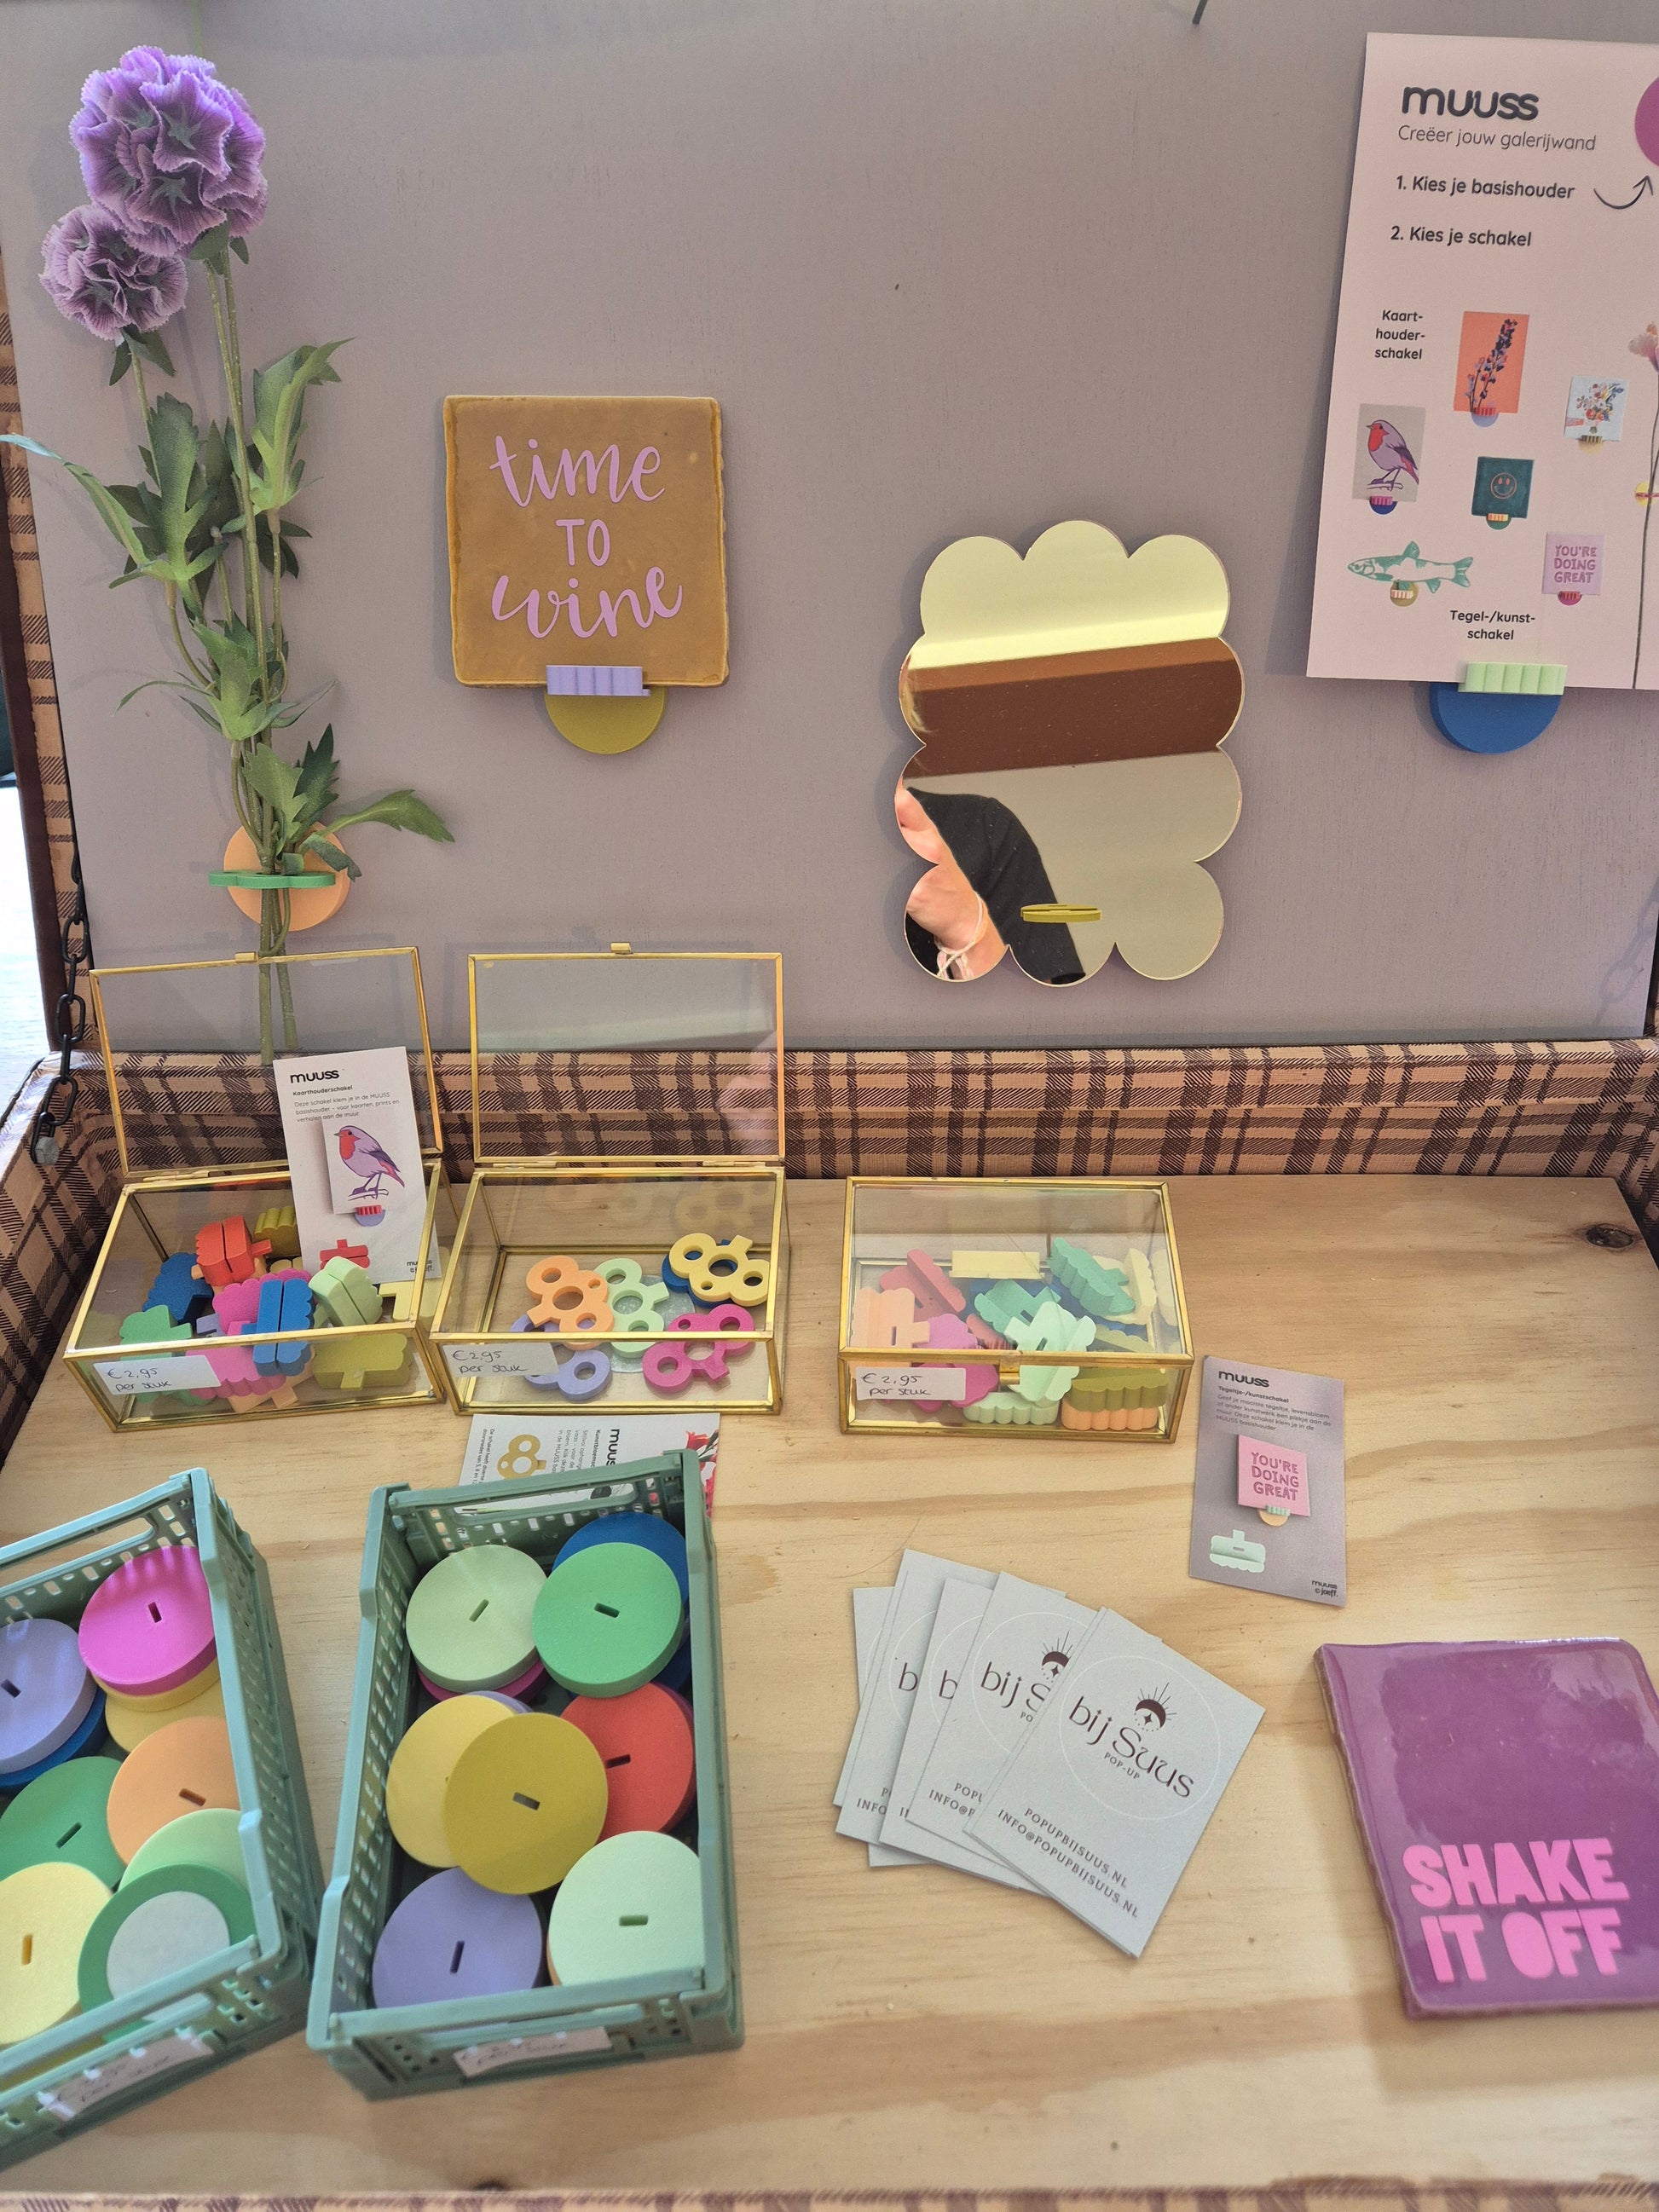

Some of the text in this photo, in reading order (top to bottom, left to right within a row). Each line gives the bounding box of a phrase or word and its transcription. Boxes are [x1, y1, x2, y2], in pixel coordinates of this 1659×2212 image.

[1402, 86, 1540, 121] muuss
[1398, 124, 1597, 153] Creëer jouw galerijwand
[1396, 175, 1575, 199] 1. Kies je basishouder
[1390, 225, 1532, 247] 2. Kies je schakel
[1382, 309, 1424, 322] Kaart-
[1375, 327, 1425, 341] houder-
[1374, 347, 1423, 360] schakel
[488, 435, 666, 508] time
[555, 518, 611, 567] TO
[1554, 545, 1598, 557] YOU'RE
[1553, 557, 1597, 571] DOING
[1553, 571, 1594, 584] GREAT
[491, 566, 683, 639] wine
[1449, 609, 1536, 624] Tegel-/kunst-
[1467, 628, 1514, 640] schakel
[290, 1070, 340, 1083] muuss
[292, 1085, 353, 1096] Kaarthouderschakel
[458, 1365, 484, 1374] per
[1217, 1371, 1269, 1388] muuss
[115, 1383, 135, 1393] per
[869, 1387, 932, 1397] per stuk
[606, 1429, 620, 1465] muus
[1251, 1452, 1299, 1475] YOU'RE
[1251, 1464, 1299, 1488] DOING
[1253, 1481, 1298, 1501] GREAT
[980, 1661, 1022, 1708] bij
[1068, 1695, 1113, 1746] bij
[1112, 1727, 1194, 1798] Suus
[1103, 1751, 1141, 1780] POP-UP
[1024, 1807, 1128, 1889] POPUPBIJSUUS.NL
[997, 1809, 1139, 1919] INFO@POPUPBIJSUUS.NL
[1402, 1838, 1629, 1907] SHAKE
[1420, 1908, 1621, 1982] IT OFF
